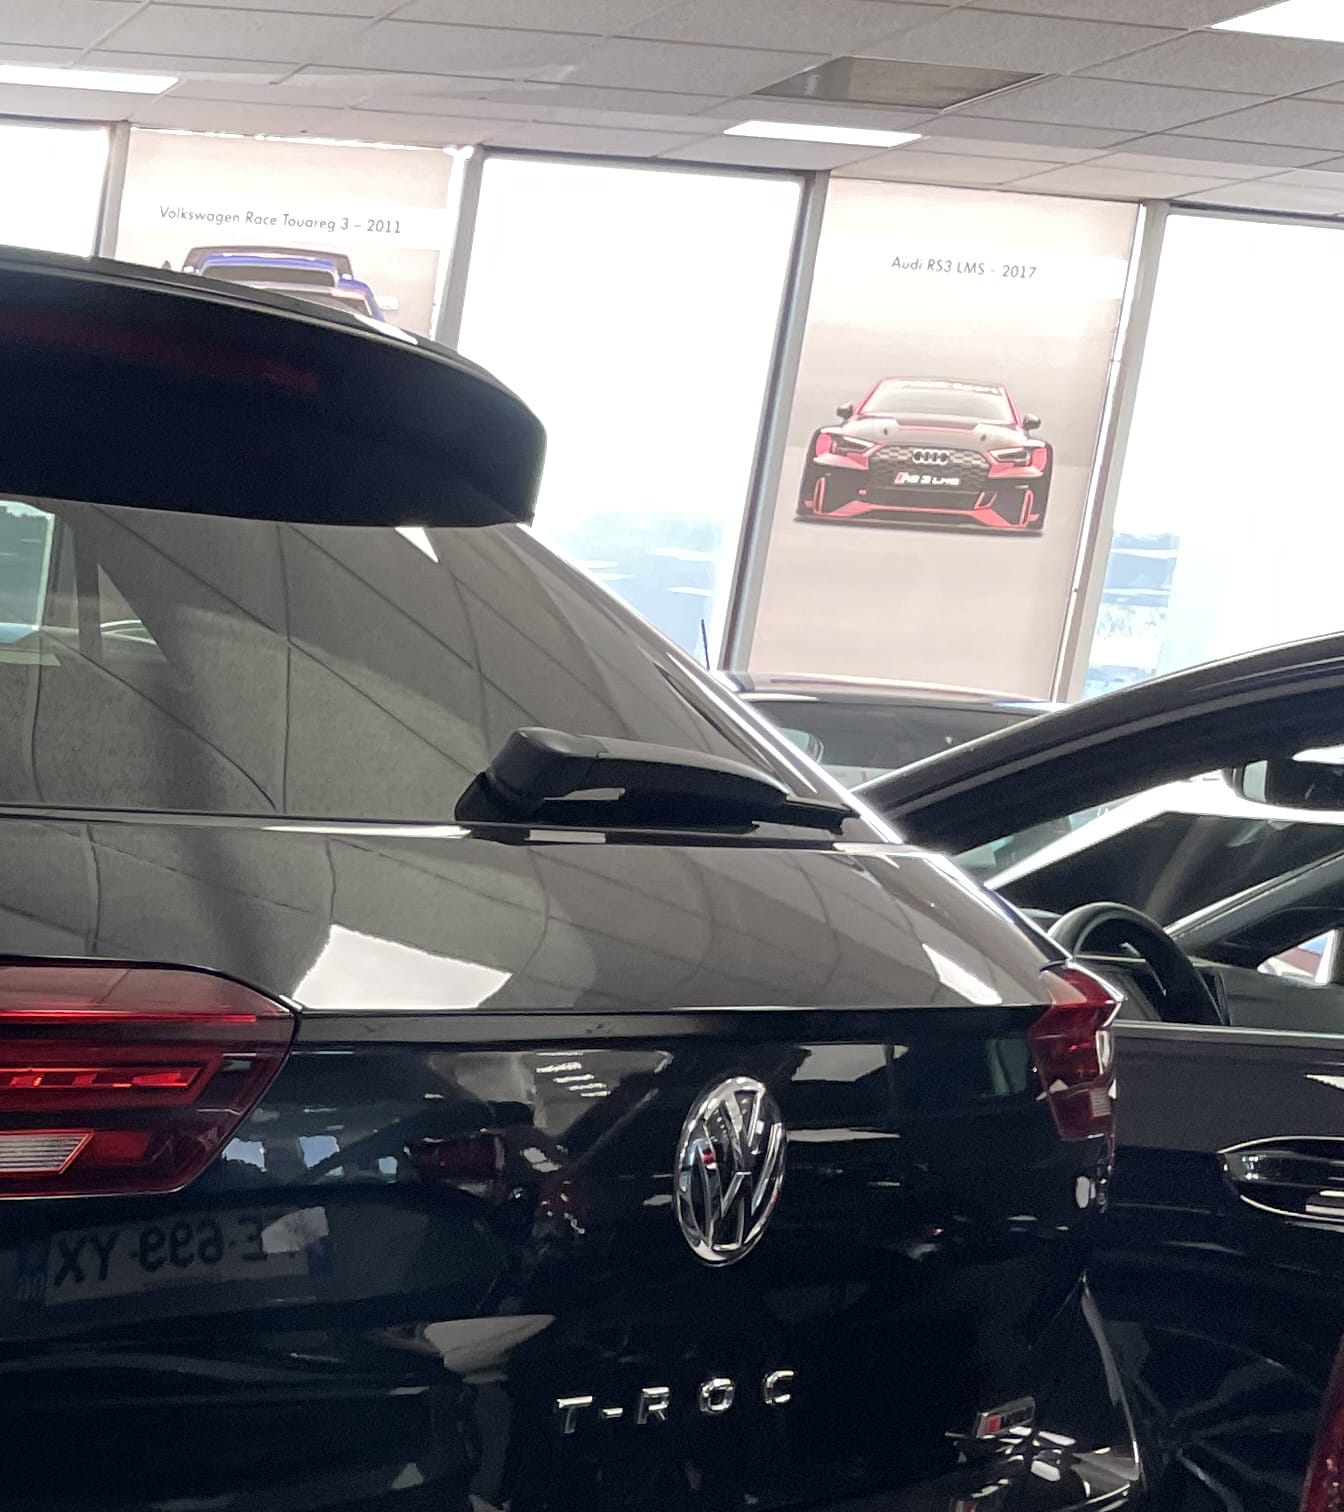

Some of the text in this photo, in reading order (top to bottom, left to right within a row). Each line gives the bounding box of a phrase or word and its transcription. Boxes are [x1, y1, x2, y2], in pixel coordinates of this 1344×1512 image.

[160, 205, 240, 226] Volkswagen
[246, 211, 277, 225] Race
[283, 214, 336, 232] Touareg
[341, 217, 349, 230] 3
[367, 219, 400, 233] 2011
[891, 256, 922, 270] Audi
[927, 259, 952, 273] RS3
[957, 261, 985, 275] LMS
[1002, 264, 1038, 279] 2017
[555, 1370, 794, 1435] T-ROC
